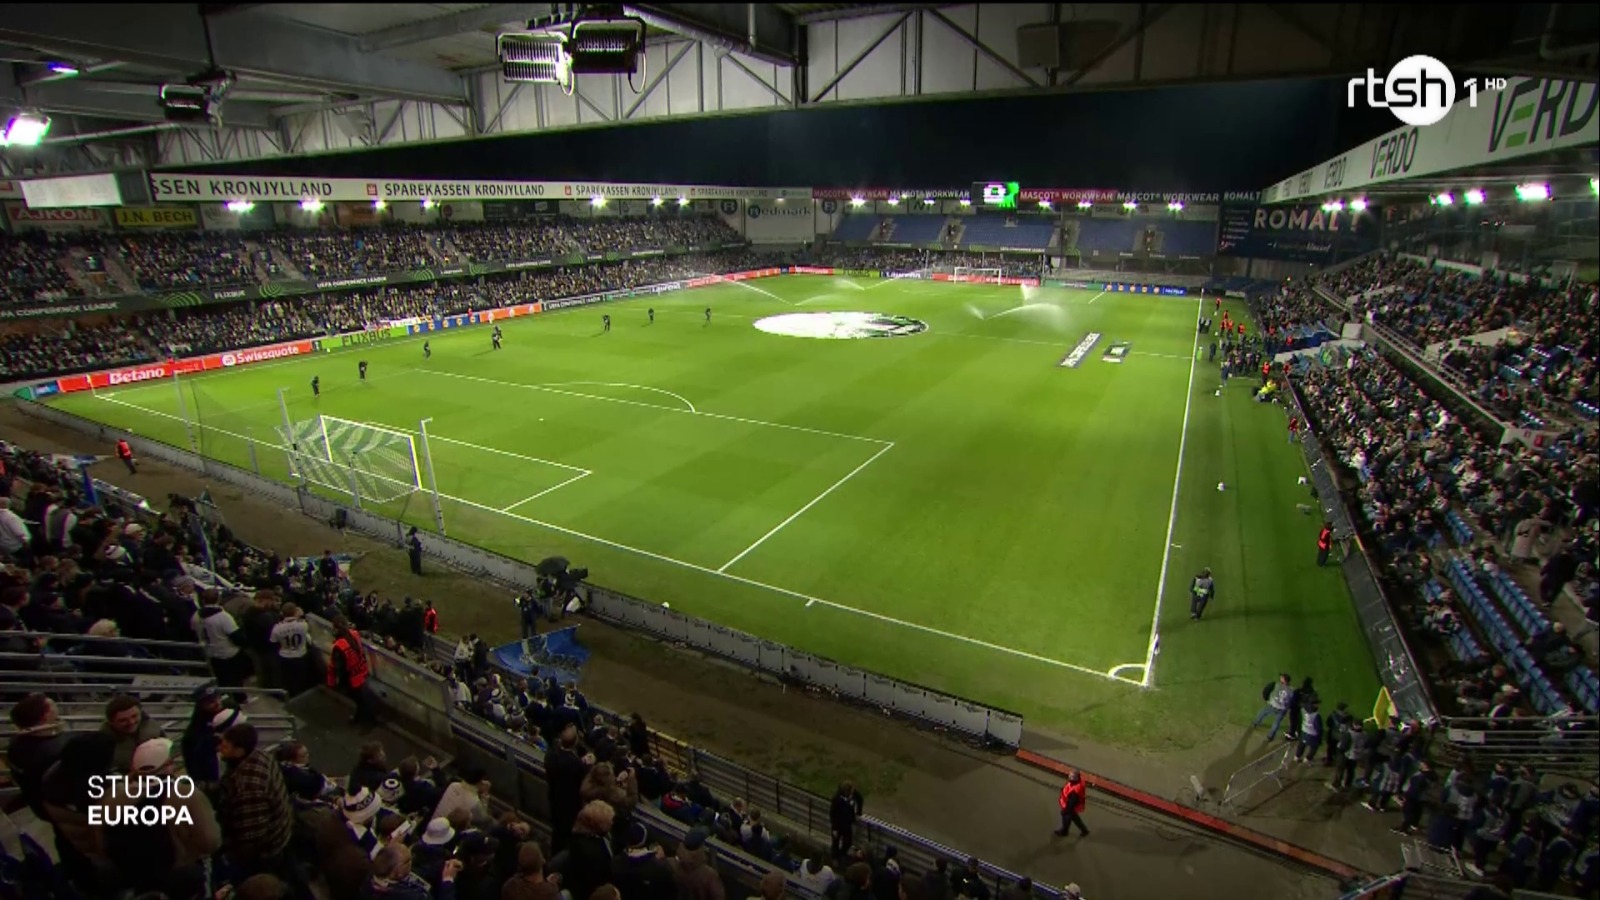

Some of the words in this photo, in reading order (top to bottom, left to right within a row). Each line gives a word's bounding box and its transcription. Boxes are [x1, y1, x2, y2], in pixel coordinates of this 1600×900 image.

[1370, 127, 1419, 179] VERDO
[209, 180, 333, 196] KRONJYLLAND
[384, 182, 470, 197] SPAREKASSEN
[474, 183, 545, 197] KRONJYLLAND
[575, 185, 629, 197] SPAREKASSEN
[1061, 191, 1114, 202] WORKWEAR
[1162, 192, 1220, 203] WORKWEAR
[1223, 190, 1261, 201] ROMALT
[121, 211, 148, 223] J.N.
[153, 210, 193, 223] BECH
[234, 344, 300, 363] Swissquote
[109, 367, 165, 385] Betano
